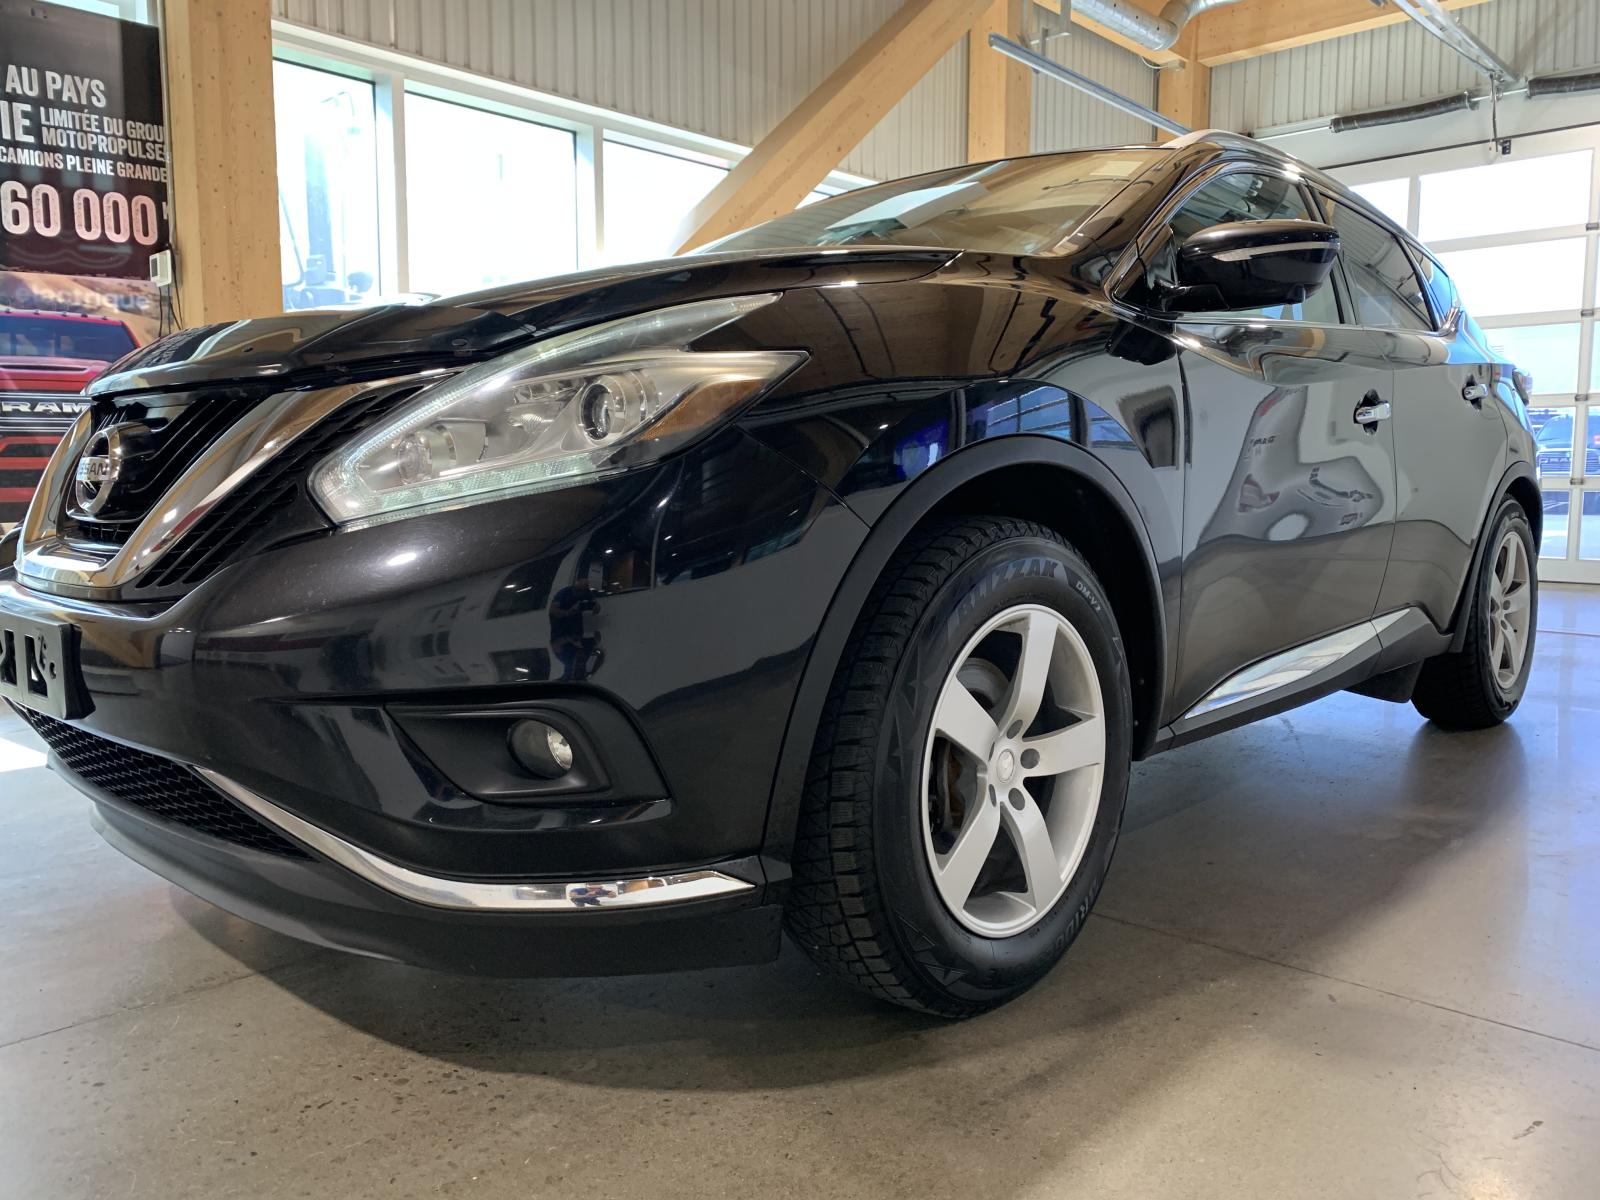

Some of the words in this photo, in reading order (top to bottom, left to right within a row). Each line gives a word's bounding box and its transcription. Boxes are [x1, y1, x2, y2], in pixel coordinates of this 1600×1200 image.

[5, 64, 39, 97] AU
[45, 70, 106, 109] PAYS
[40, 106, 100, 133] LIMITÉE
[102, 116, 123, 137] DU
[0, 145, 64, 170] CAMIONS
[65, 153, 115, 177] PLEINE
[116, 161, 168, 183] GRANDE
[73, 188, 159, 246] 000
[1, 401, 91, 413] RAM
